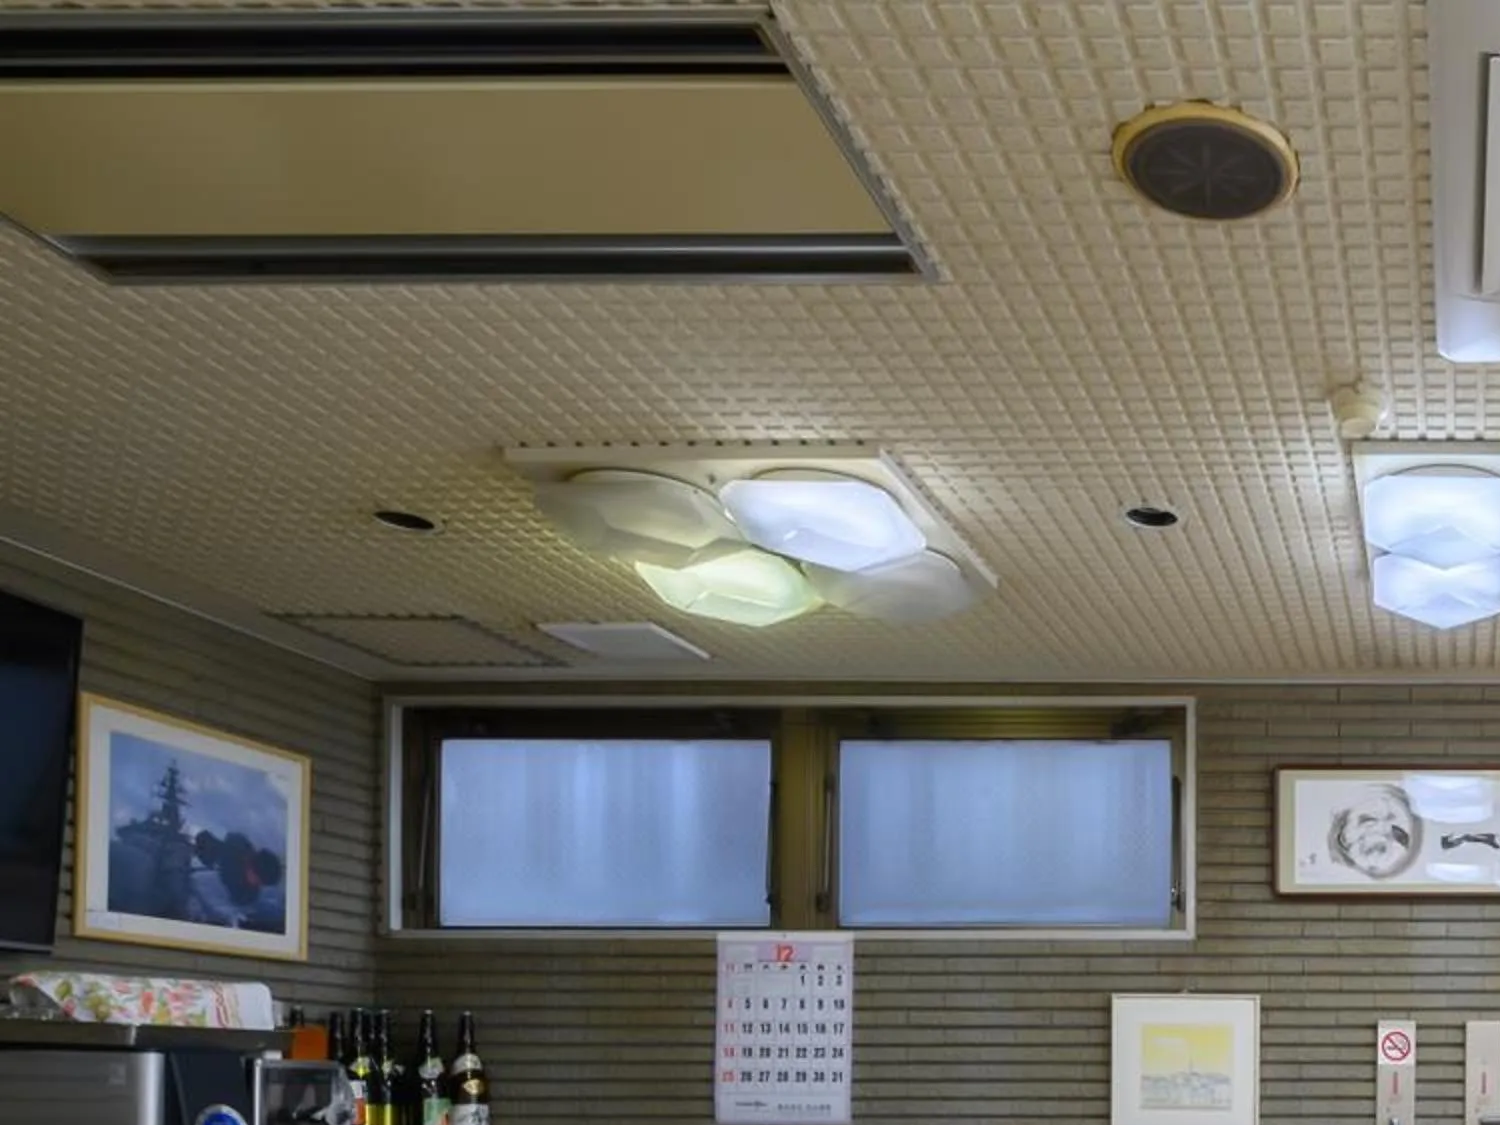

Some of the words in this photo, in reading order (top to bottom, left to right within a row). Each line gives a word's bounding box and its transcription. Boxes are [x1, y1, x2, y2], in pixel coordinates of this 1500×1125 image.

[776, 944, 794, 963] 12
[741, 1022, 754, 1034] 12
[759, 1022, 772, 1034] 13
[778, 1023, 791, 1034] 14
[833, 1022, 845, 1034] 17
[777, 1047, 789, 1058] 21
[795, 1047, 808, 1058] 22
[813, 1048, 826, 1058] 23
[831, 1048, 844, 1058] 24
[758, 1071, 771, 1082] 27
[831, 1072, 843, 1082] 31
